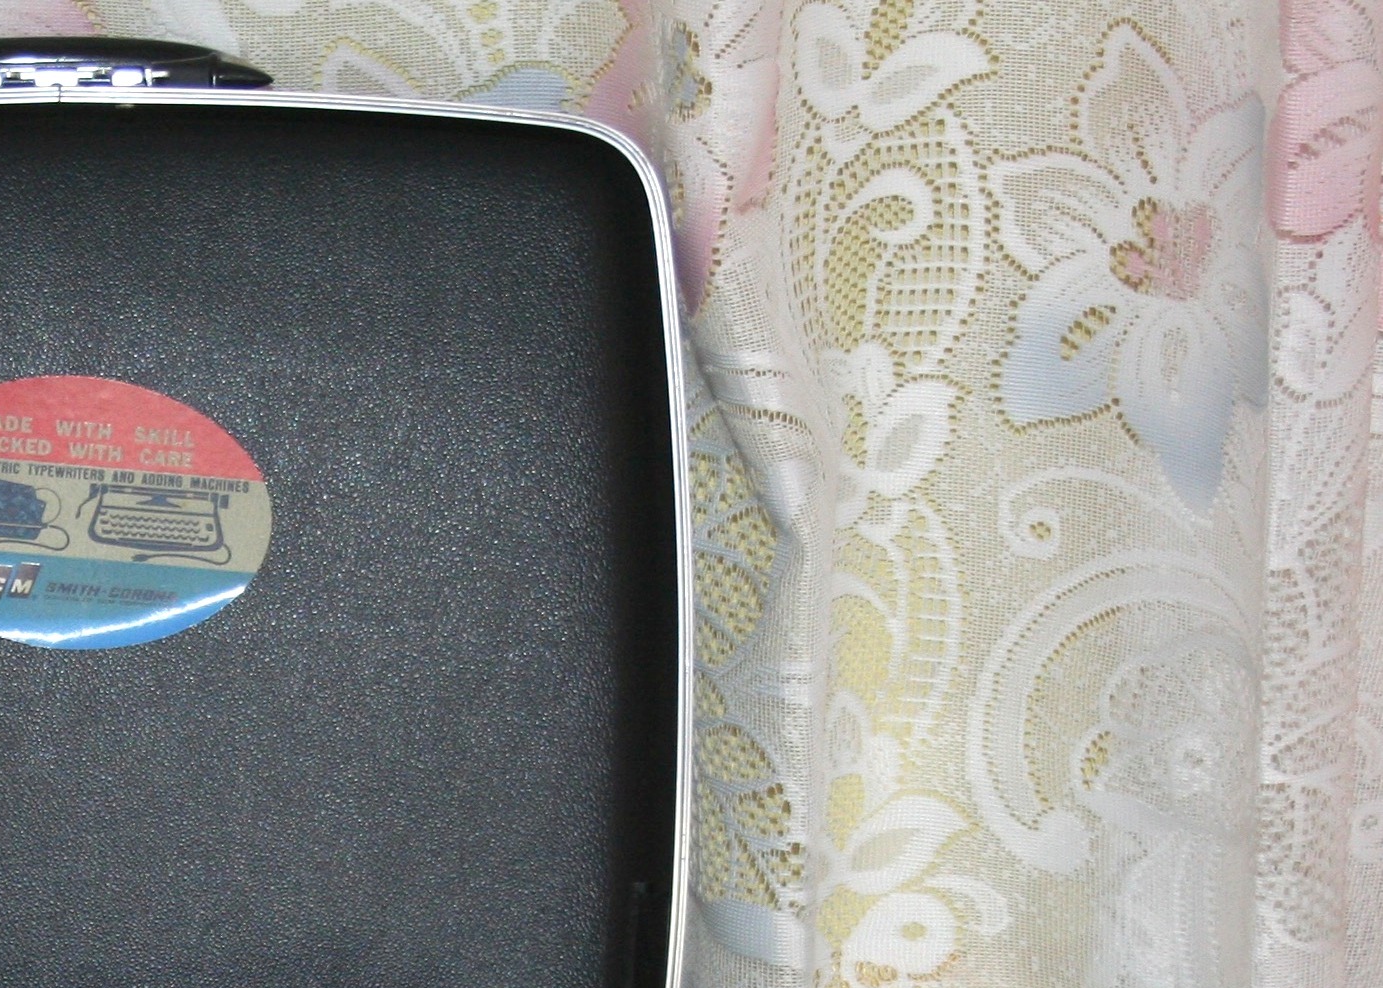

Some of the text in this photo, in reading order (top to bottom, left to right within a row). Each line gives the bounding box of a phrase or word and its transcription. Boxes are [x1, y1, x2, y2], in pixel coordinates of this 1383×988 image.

[55, 418, 112, 440] WITH
[134, 426, 195, 448] SKILL
[69, 441, 124, 462] WITH
[139, 448, 194, 468] CARE
[27, 463, 106, 482] TYPEWRITERS
[111, 471, 135, 485] AND
[141, 473, 183, 489] ADDING
[189, 476, 250, 494] MACHINES
